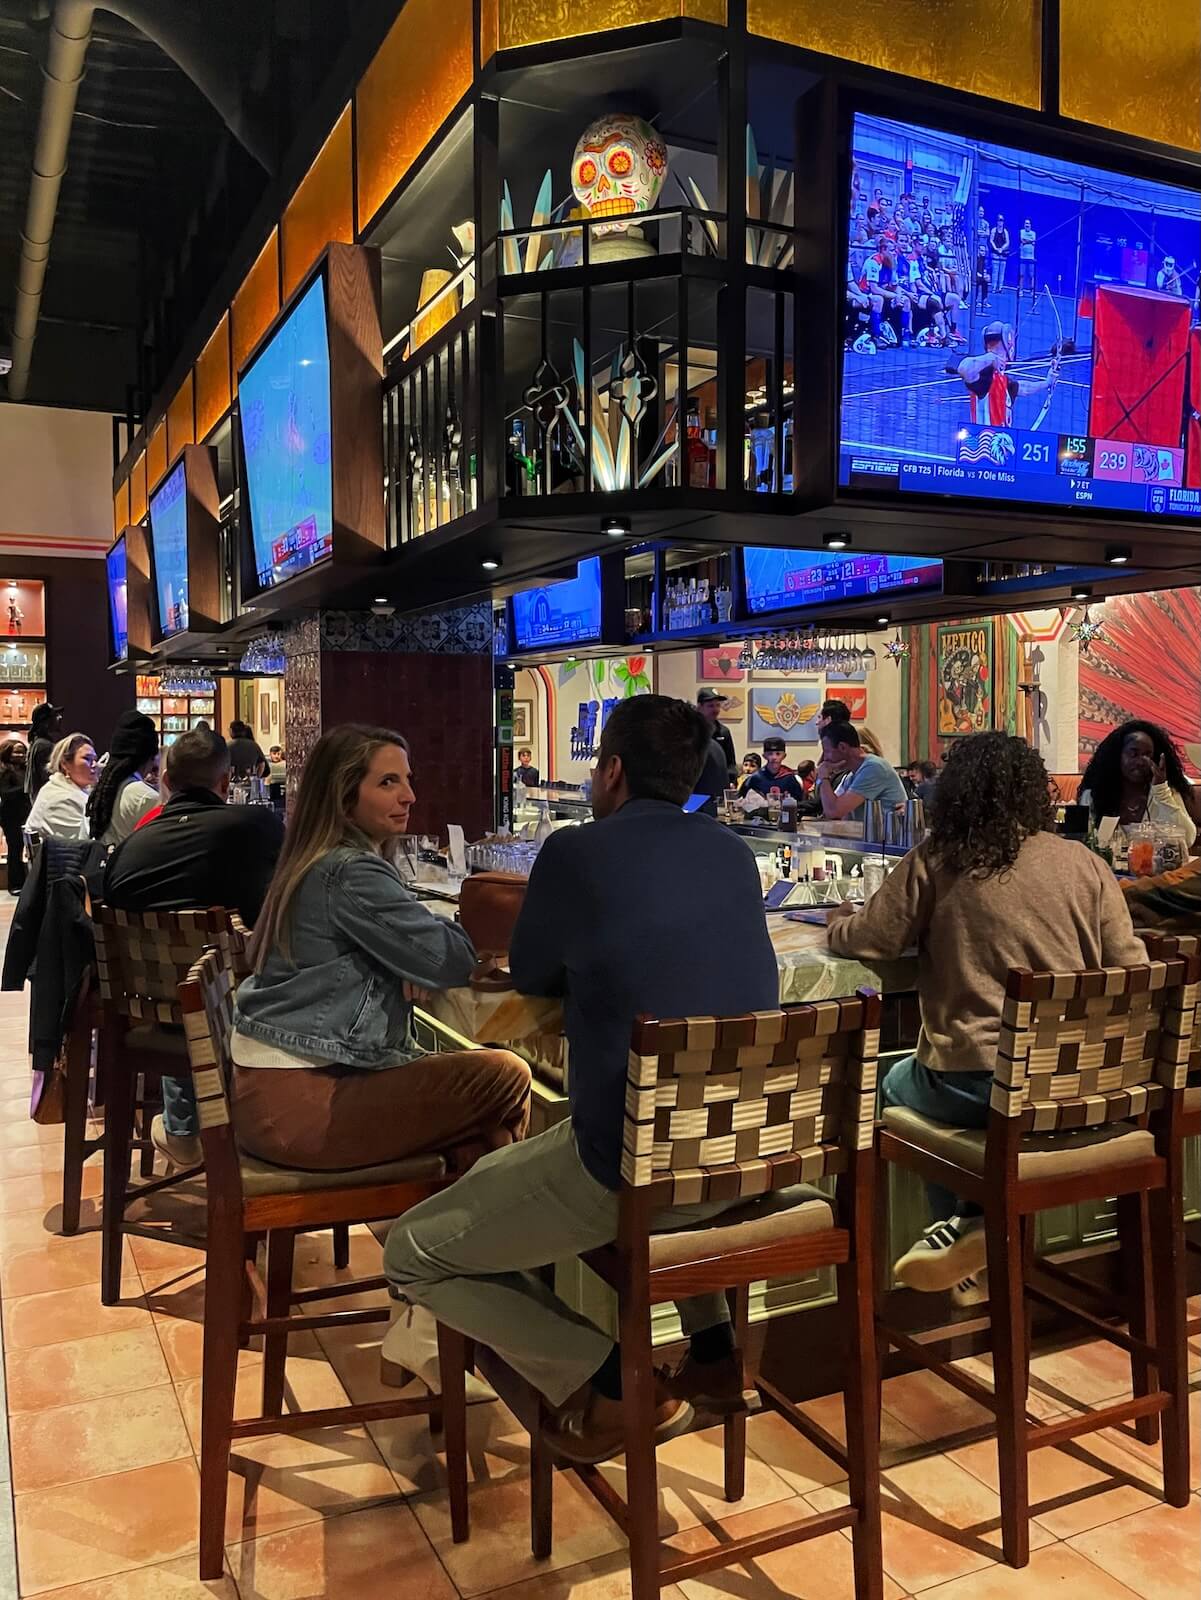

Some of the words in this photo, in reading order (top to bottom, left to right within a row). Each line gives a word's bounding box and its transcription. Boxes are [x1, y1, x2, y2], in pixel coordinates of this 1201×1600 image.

[1022, 443, 1049, 463] 251
[1066, 437, 1086, 454] 1:55
[1100, 451, 1127, 471] 239
[903, 464, 917, 474] CFB
[918, 465, 932, 475] T25
[938, 466, 965, 478] Florida
[967, 471, 976, 479] vs
[978, 470, 984, 480] 7
[985, 472, 996, 481] Ole
[997, 473, 1015, 483] Miss
[1081, 481, 1090, 490] ET
[1075, 491, 1093, 501] ESPN
[1169, 488, 1200, 504] FLORIDA
[811, 568, 822, 583] 23
[845, 562, 855, 577] 21
[942, 630, 986, 656] MEXICO
